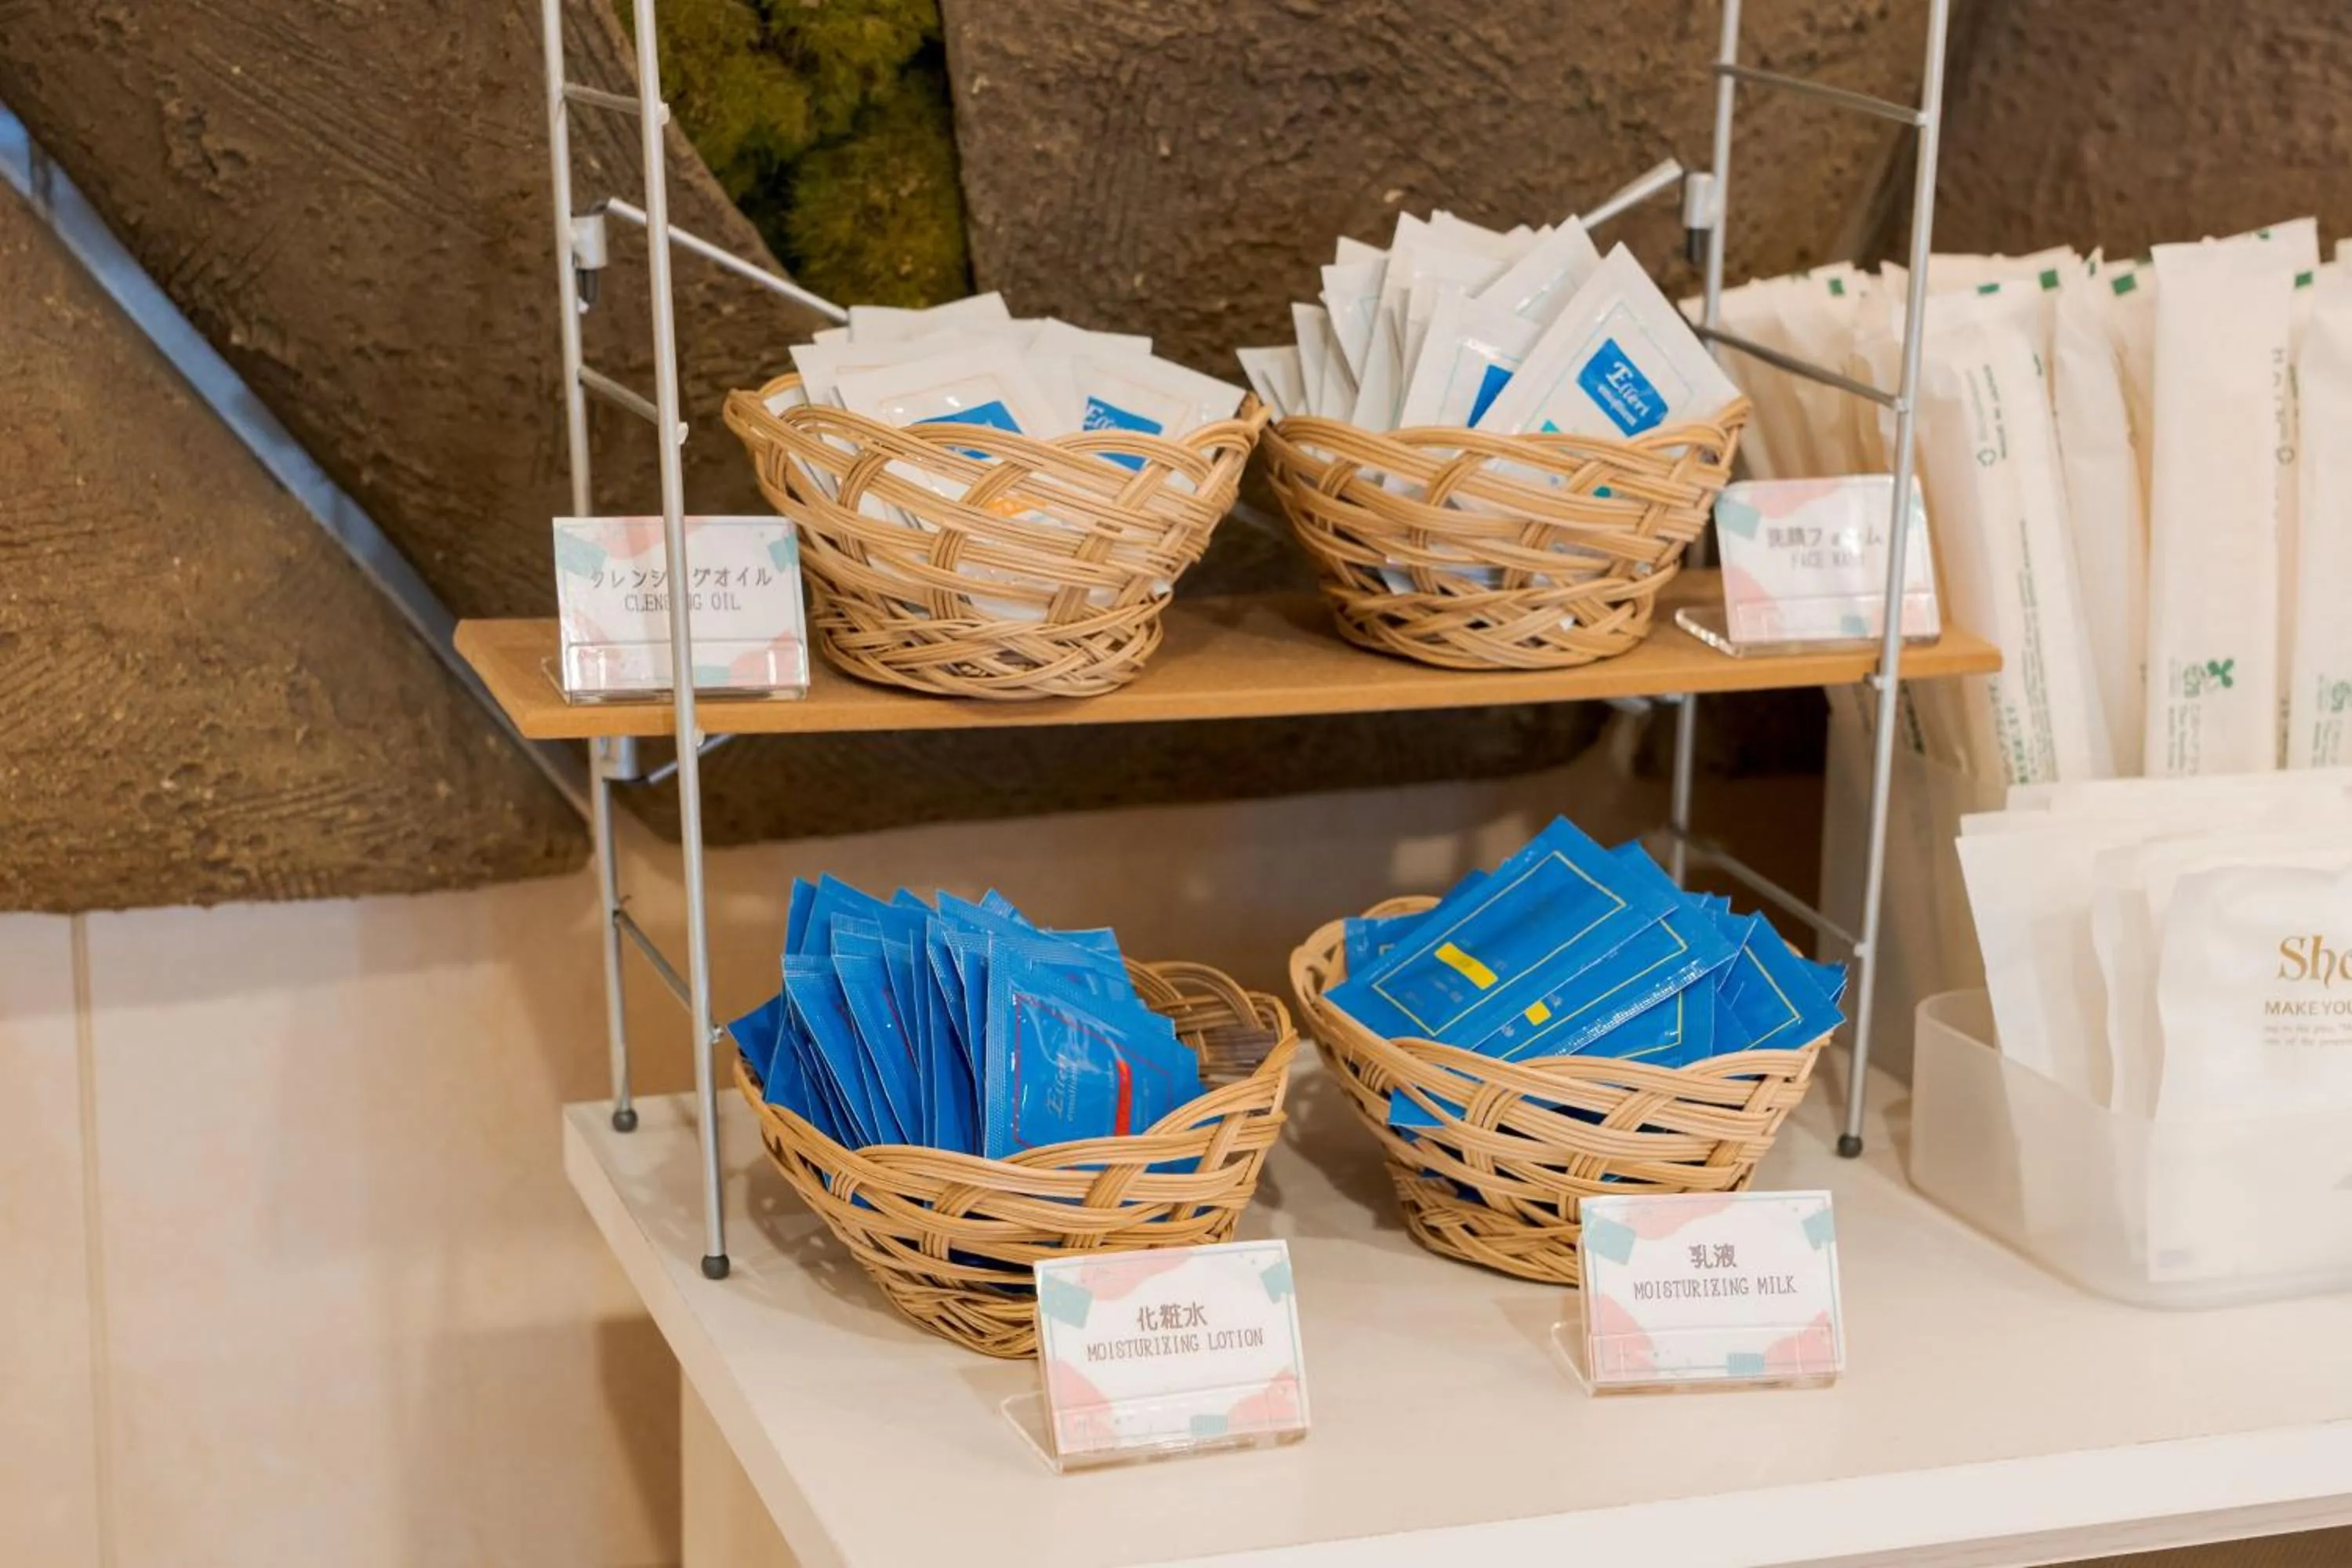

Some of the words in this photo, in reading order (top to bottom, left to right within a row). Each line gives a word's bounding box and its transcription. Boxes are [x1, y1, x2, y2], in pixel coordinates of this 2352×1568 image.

[710, 592, 741, 612] OIL
[1688, 1243, 1738, 1269] 乳液
[1633, 1278, 1750, 1301] MOISTURIZING
[1756, 1275, 1798, 1296] MILK
[1136, 1300, 1209, 1331] 化粧水
[1207, 1327, 1264, 1351] LOTION
